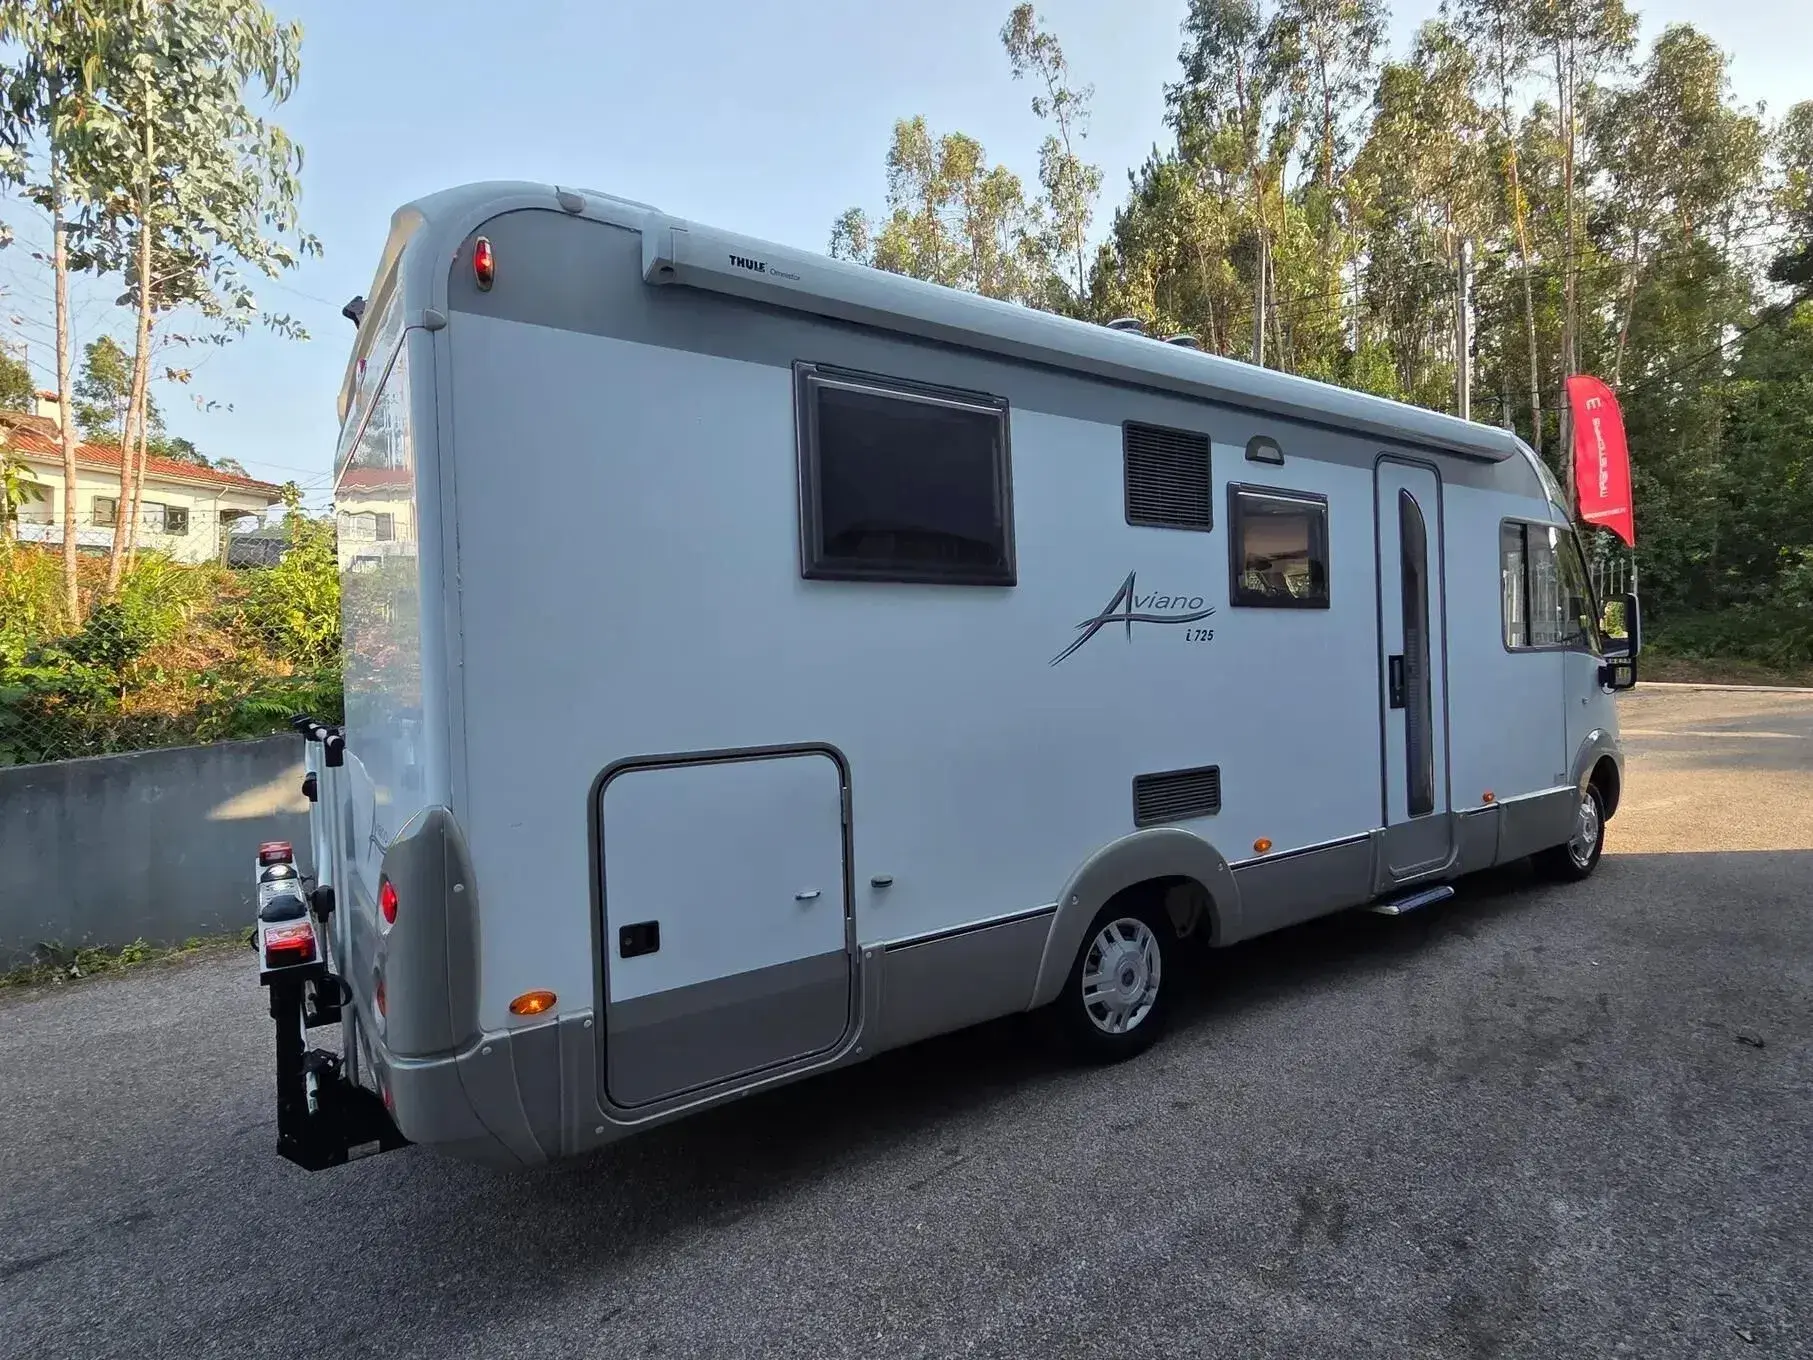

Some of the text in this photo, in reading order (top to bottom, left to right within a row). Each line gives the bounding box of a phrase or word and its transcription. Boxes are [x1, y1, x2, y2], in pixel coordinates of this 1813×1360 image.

[729, 255, 766, 273] THULE
[1048, 569, 1214, 666] Aviano
[1194, 630, 1215, 642] 725
